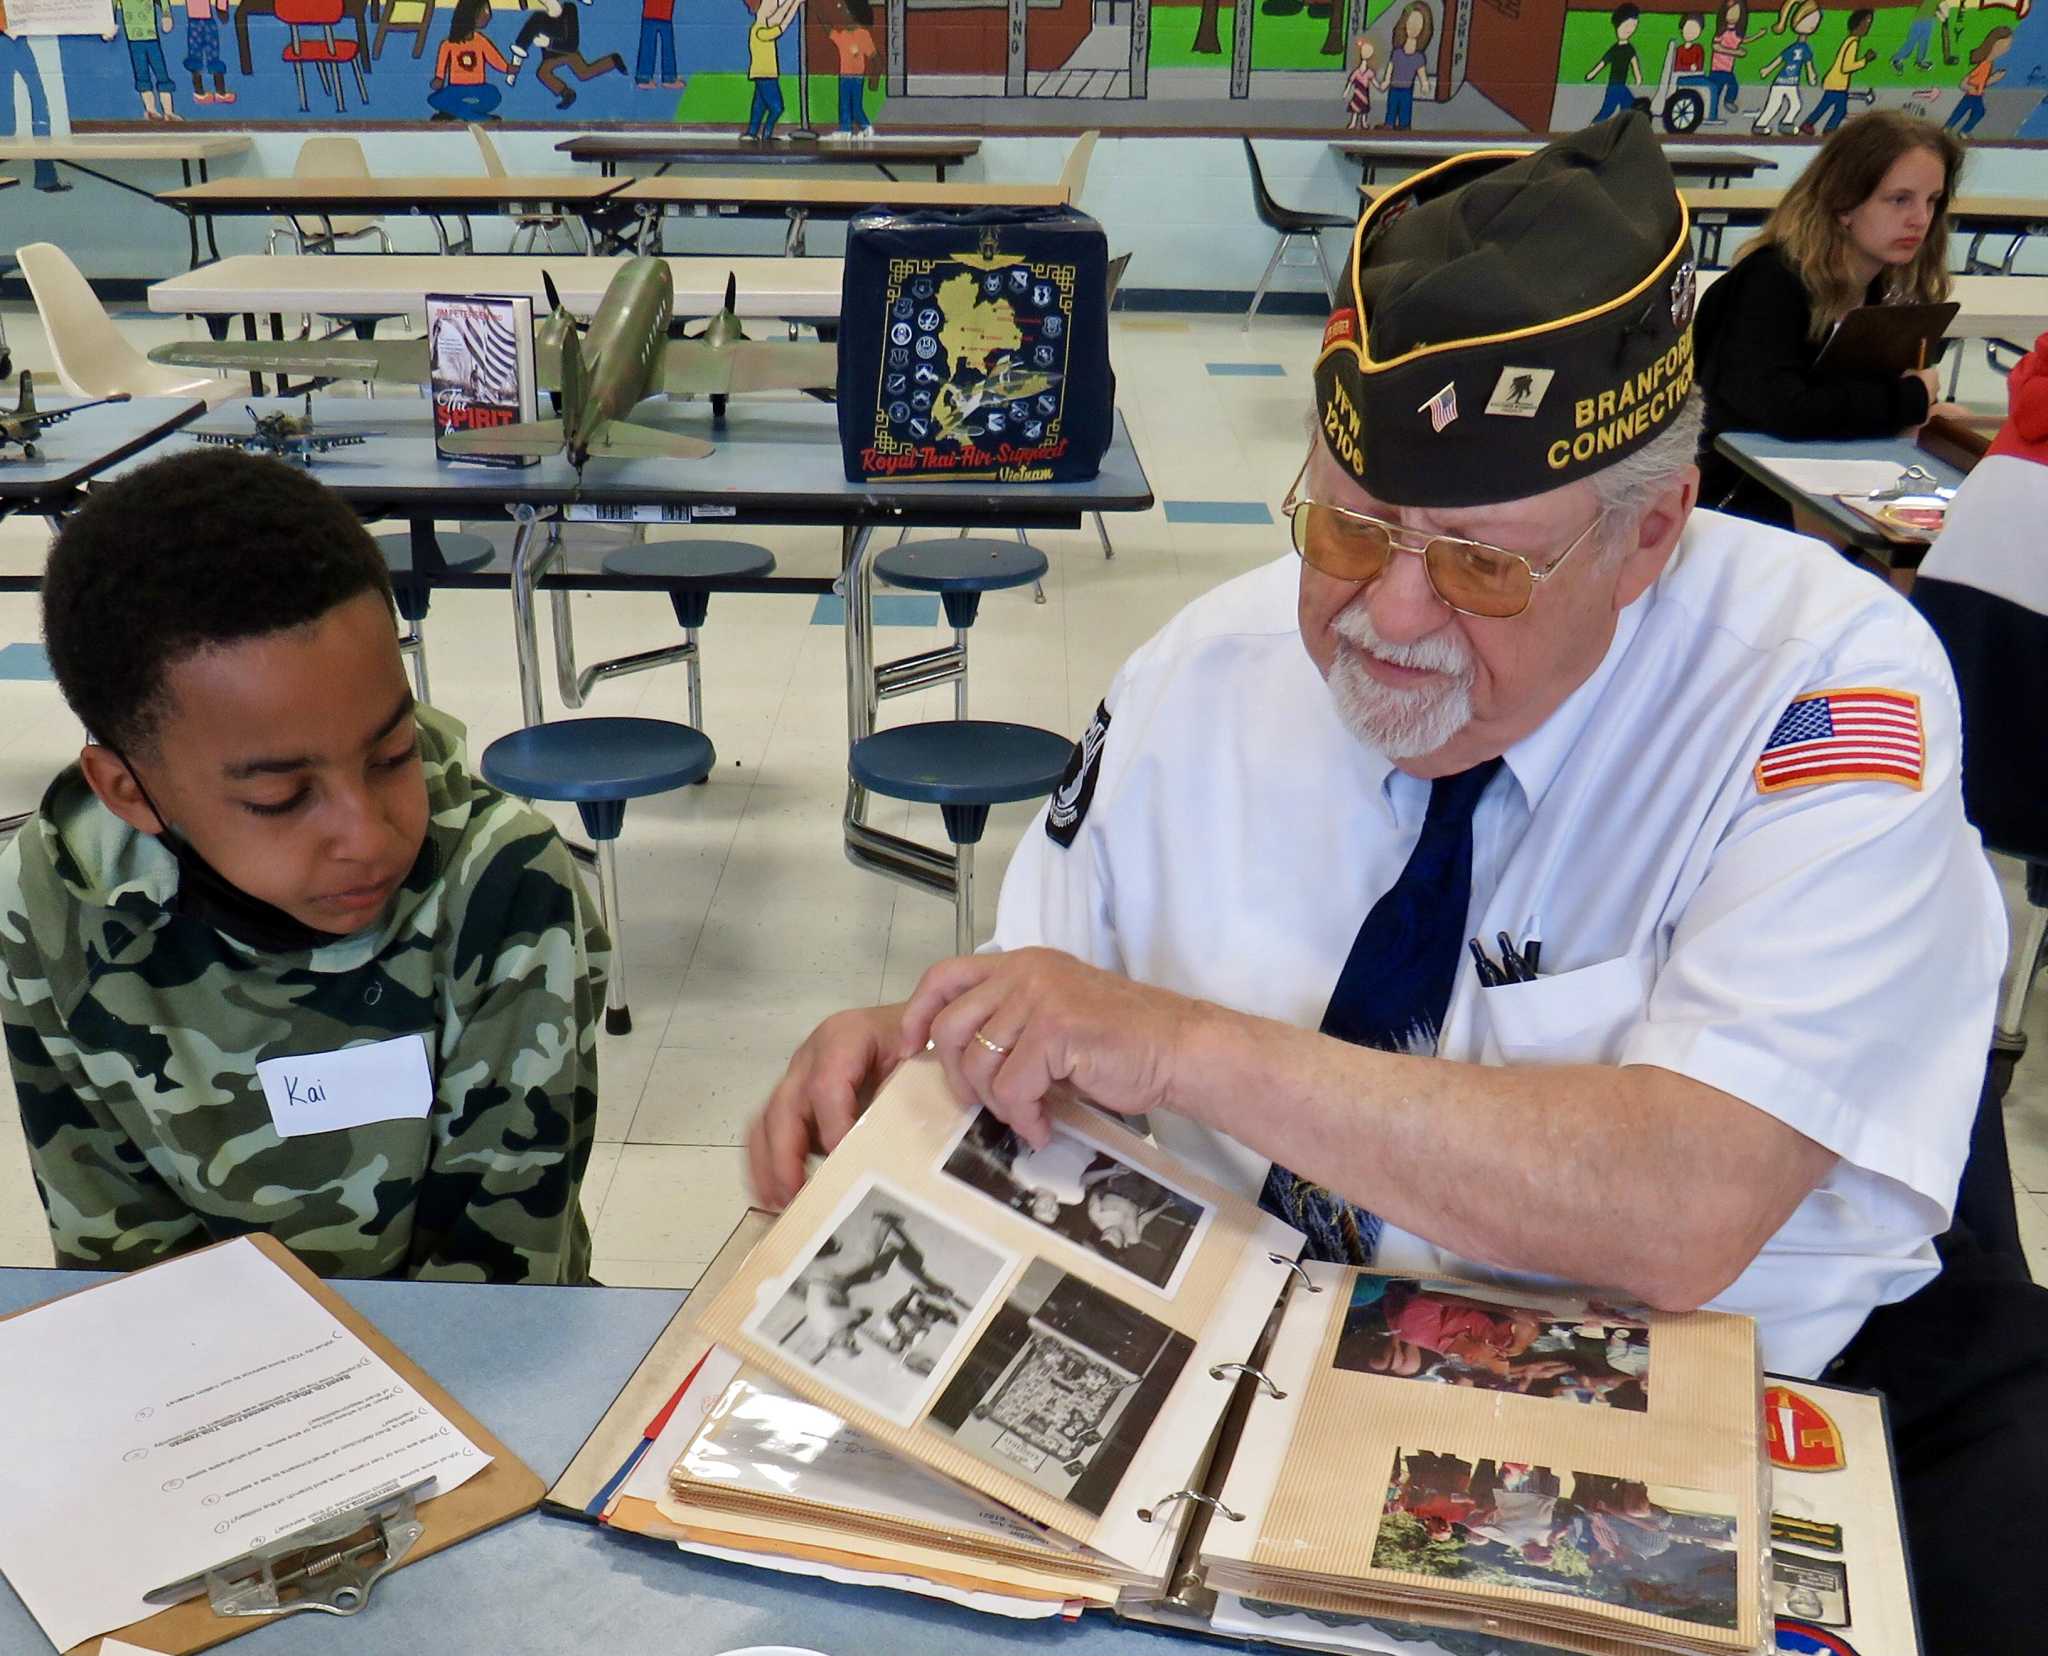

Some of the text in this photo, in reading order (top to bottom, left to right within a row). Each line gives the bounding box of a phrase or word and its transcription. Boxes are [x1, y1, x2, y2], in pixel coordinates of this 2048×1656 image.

[437, 405, 513, 429] SPIRIT
[861, 447, 917, 475] Royal
[998, 438, 1068, 466] Support
[1000, 463, 1054, 482] Vietnam
[283, 1075, 327, 1106] Kai
